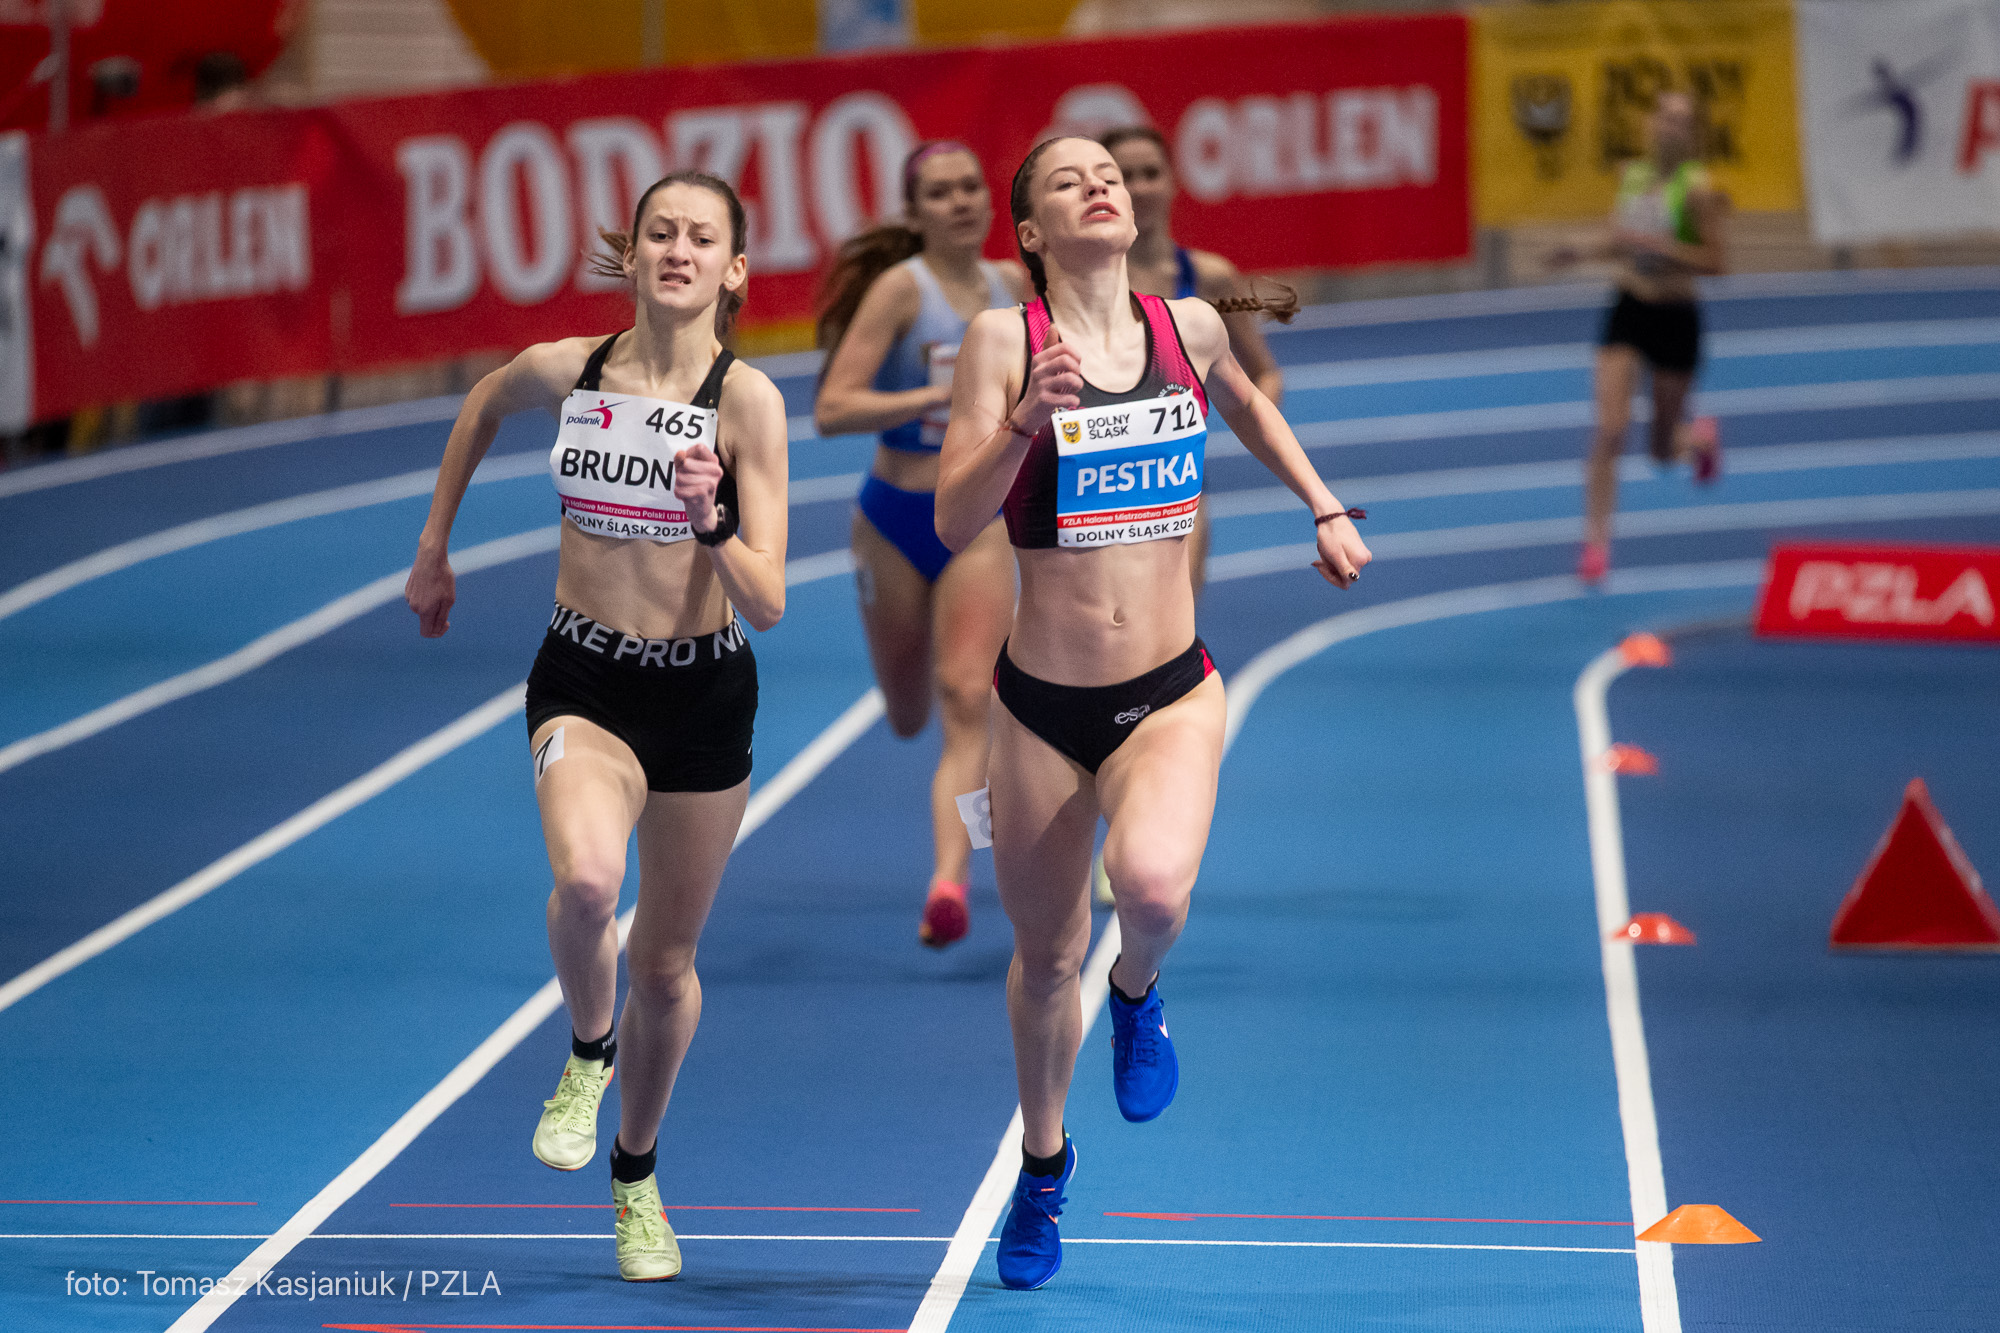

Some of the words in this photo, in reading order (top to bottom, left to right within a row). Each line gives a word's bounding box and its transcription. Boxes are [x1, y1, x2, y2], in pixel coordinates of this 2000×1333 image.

[1176, 84, 1438, 202] ORLEN
[128, 184, 309, 311] ORLEN
[566, 415, 602, 427] polanik
[645, 407, 705, 440] 465
[1087, 414, 1130, 429] DOLNY
[1089, 425, 1130, 440] ŚLĄSK
[1149, 401, 1197, 435] 712
[1077, 452, 1198, 497] PESTKA
[570, 500, 596, 511] Halowe
[597, 505, 641, 517] Mistrzostwa
[642, 511, 665, 520] Polski
[667, 513, 680, 521] U18
[1063, 519, 1081, 527] PZLA
[1114, 511, 1161, 522] Mistrzostwa
[1163, 507, 1183, 517] Polski
[607, 518, 651, 536] ŚLĄSK
[653, 526, 688, 537] 2024
[1076, 529, 1125, 543] DOLNY
[1129, 524, 1169, 538] ŚLĄSK
[1173, 518, 1195, 532] 202
[1790, 561, 1994, 626] PZLA
[613, 635, 697, 668] PRO
